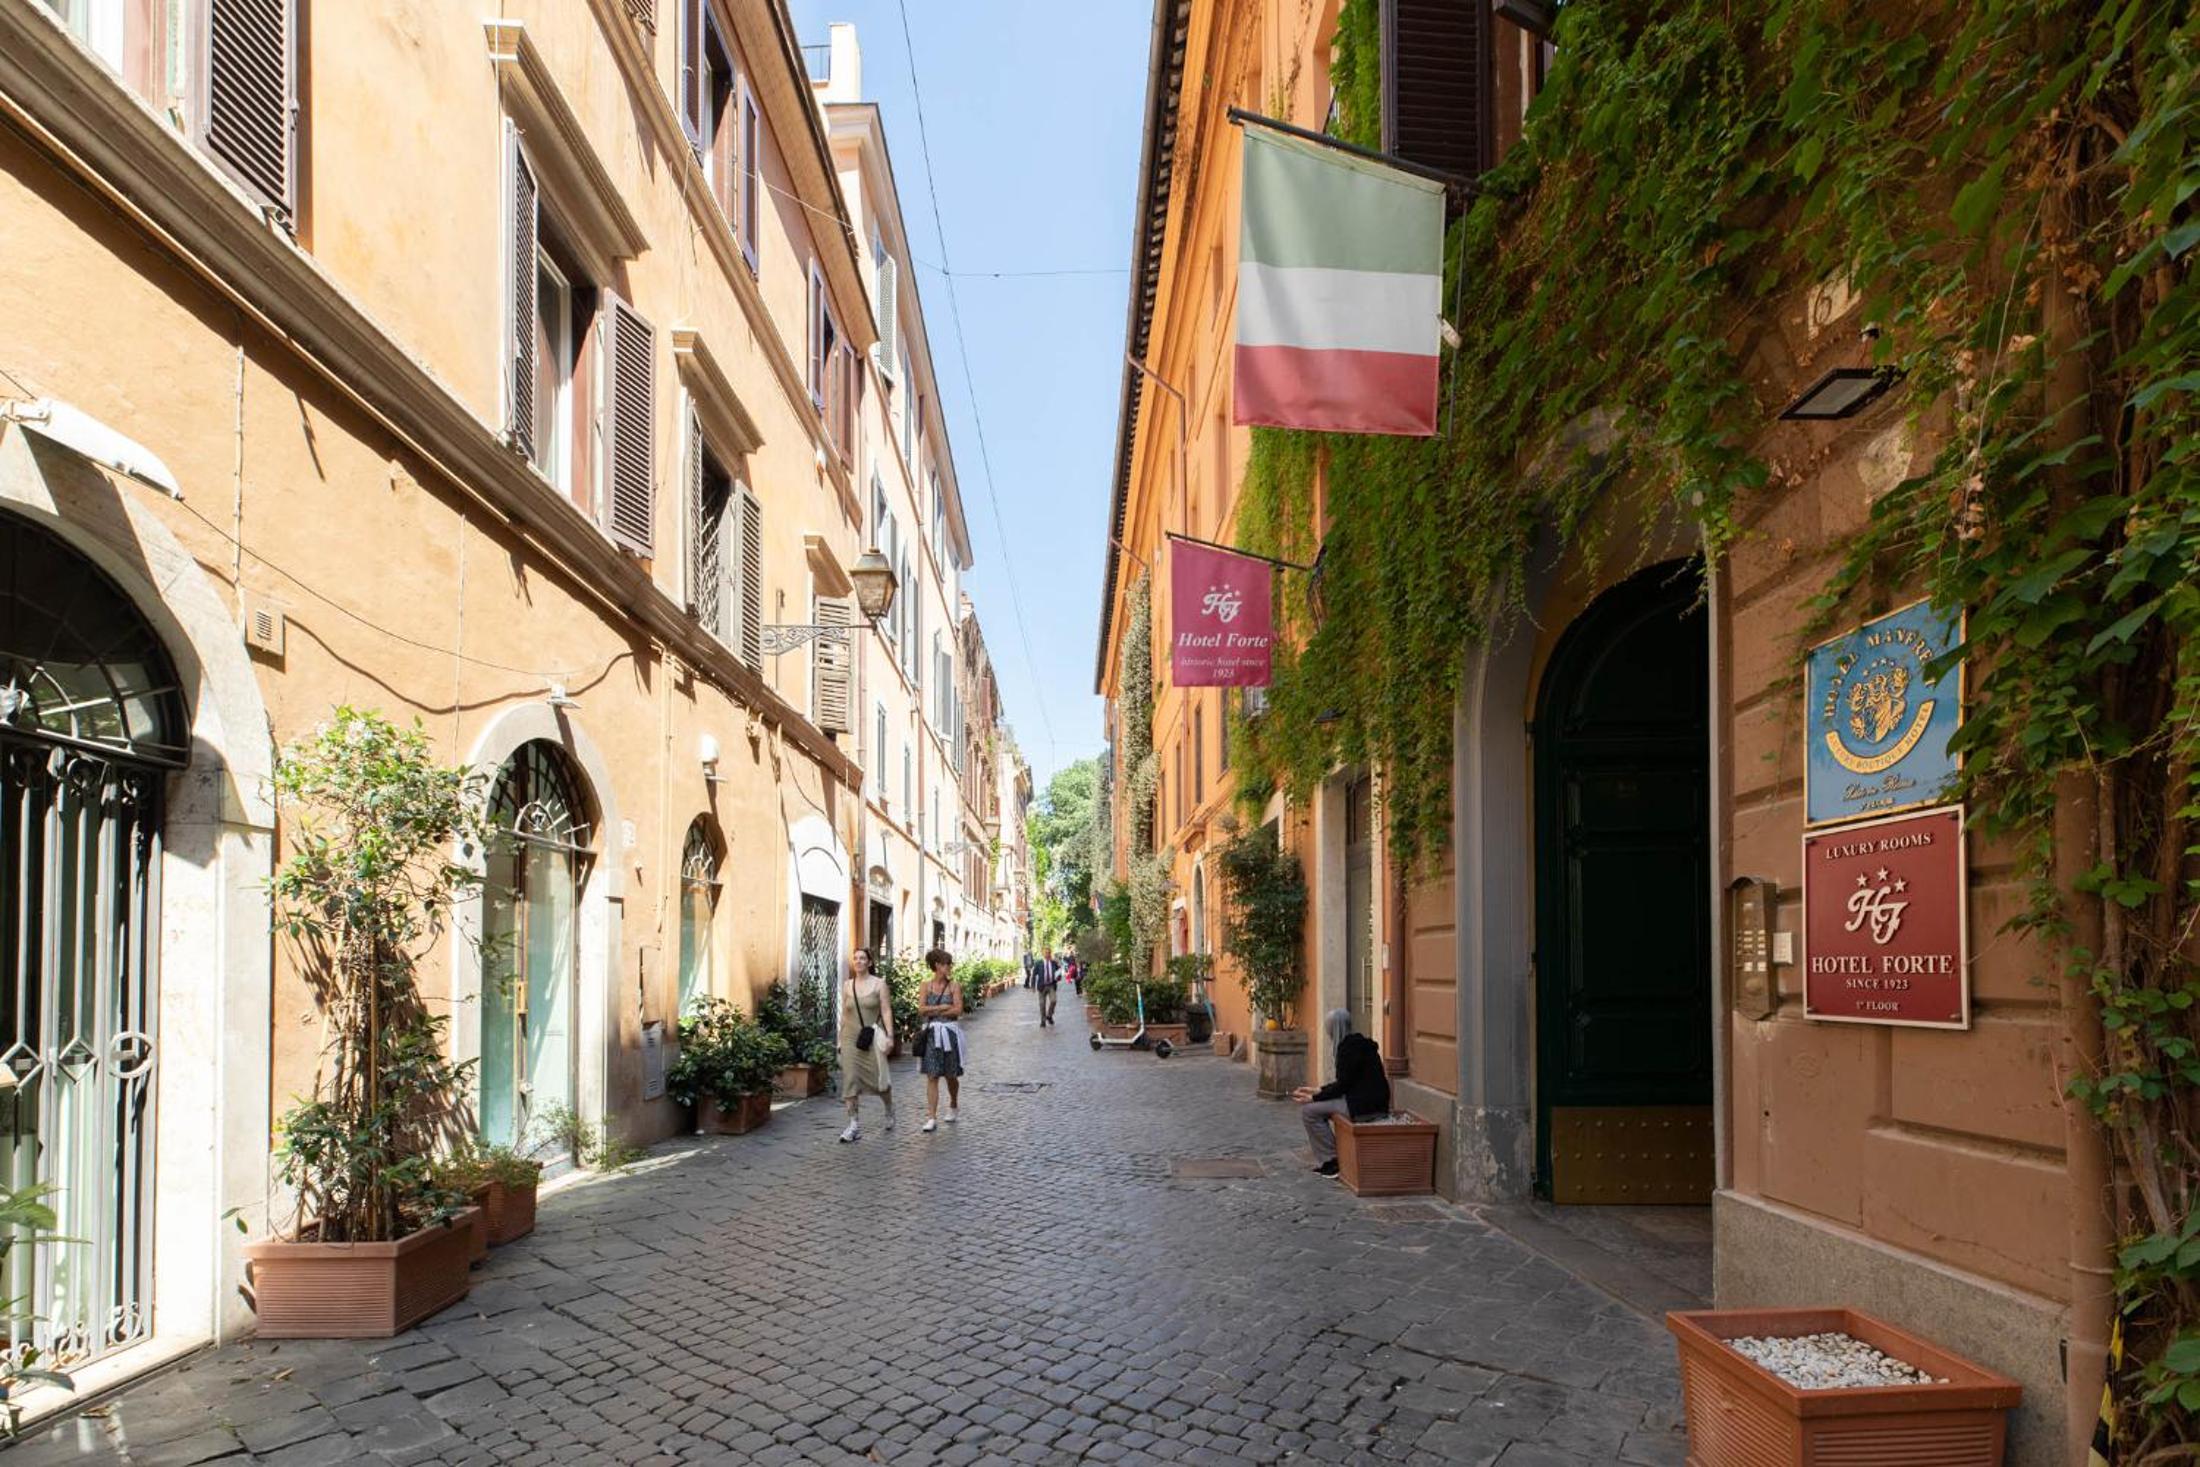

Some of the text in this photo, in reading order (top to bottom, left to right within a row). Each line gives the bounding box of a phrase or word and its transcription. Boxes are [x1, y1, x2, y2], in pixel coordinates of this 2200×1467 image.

[1178, 632, 1269, 649] Hotel Forte
[1825, 832, 1933, 860] LUXURY ROOMS
[1812, 954, 1954, 975] HOTEL FORTE
[1846, 978, 1909, 990] SINCE 1923
[1866, 1000, 1899, 1011] FLOOR
